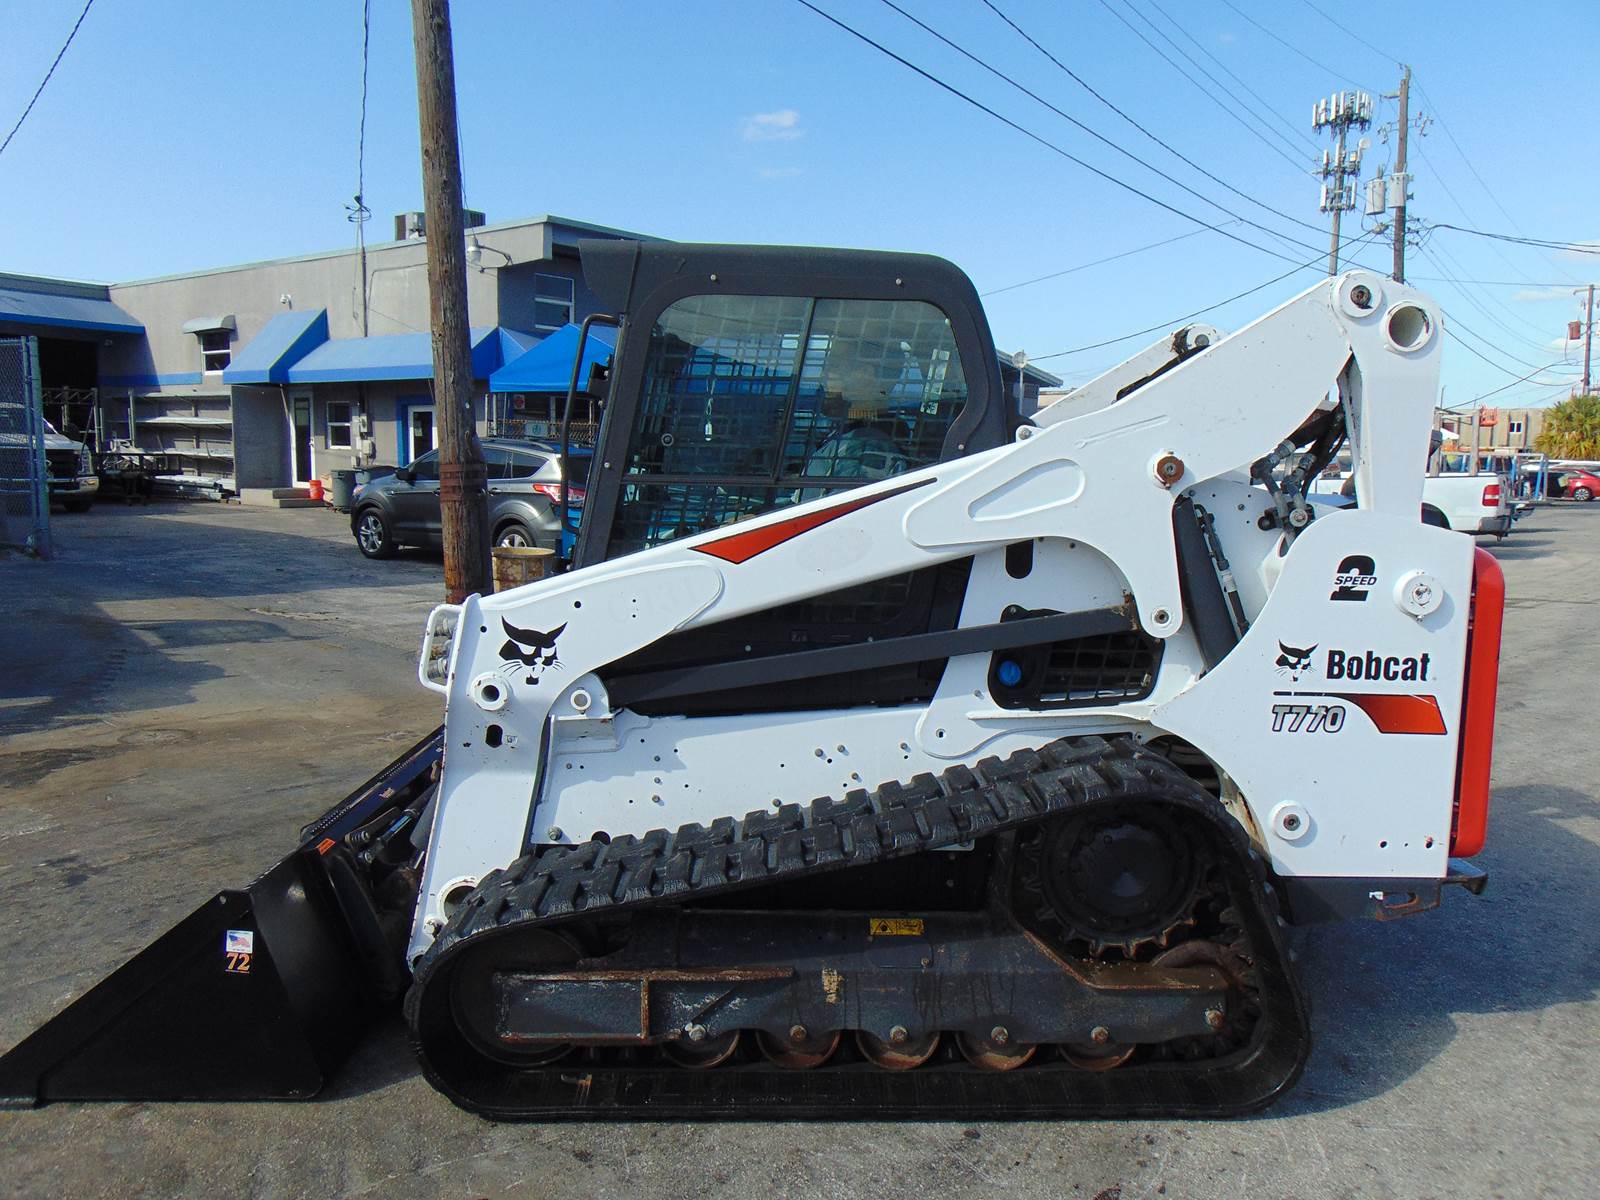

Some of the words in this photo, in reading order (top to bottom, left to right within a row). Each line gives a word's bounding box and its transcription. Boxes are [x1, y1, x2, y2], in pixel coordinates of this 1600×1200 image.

[1330, 554, 1376, 602] 2
[1334, 575, 1378, 586] SPEED
[1326, 649, 1430, 681] Bobcat
[1272, 704, 1347, 734] T770
[226, 952, 251, 971] 72
